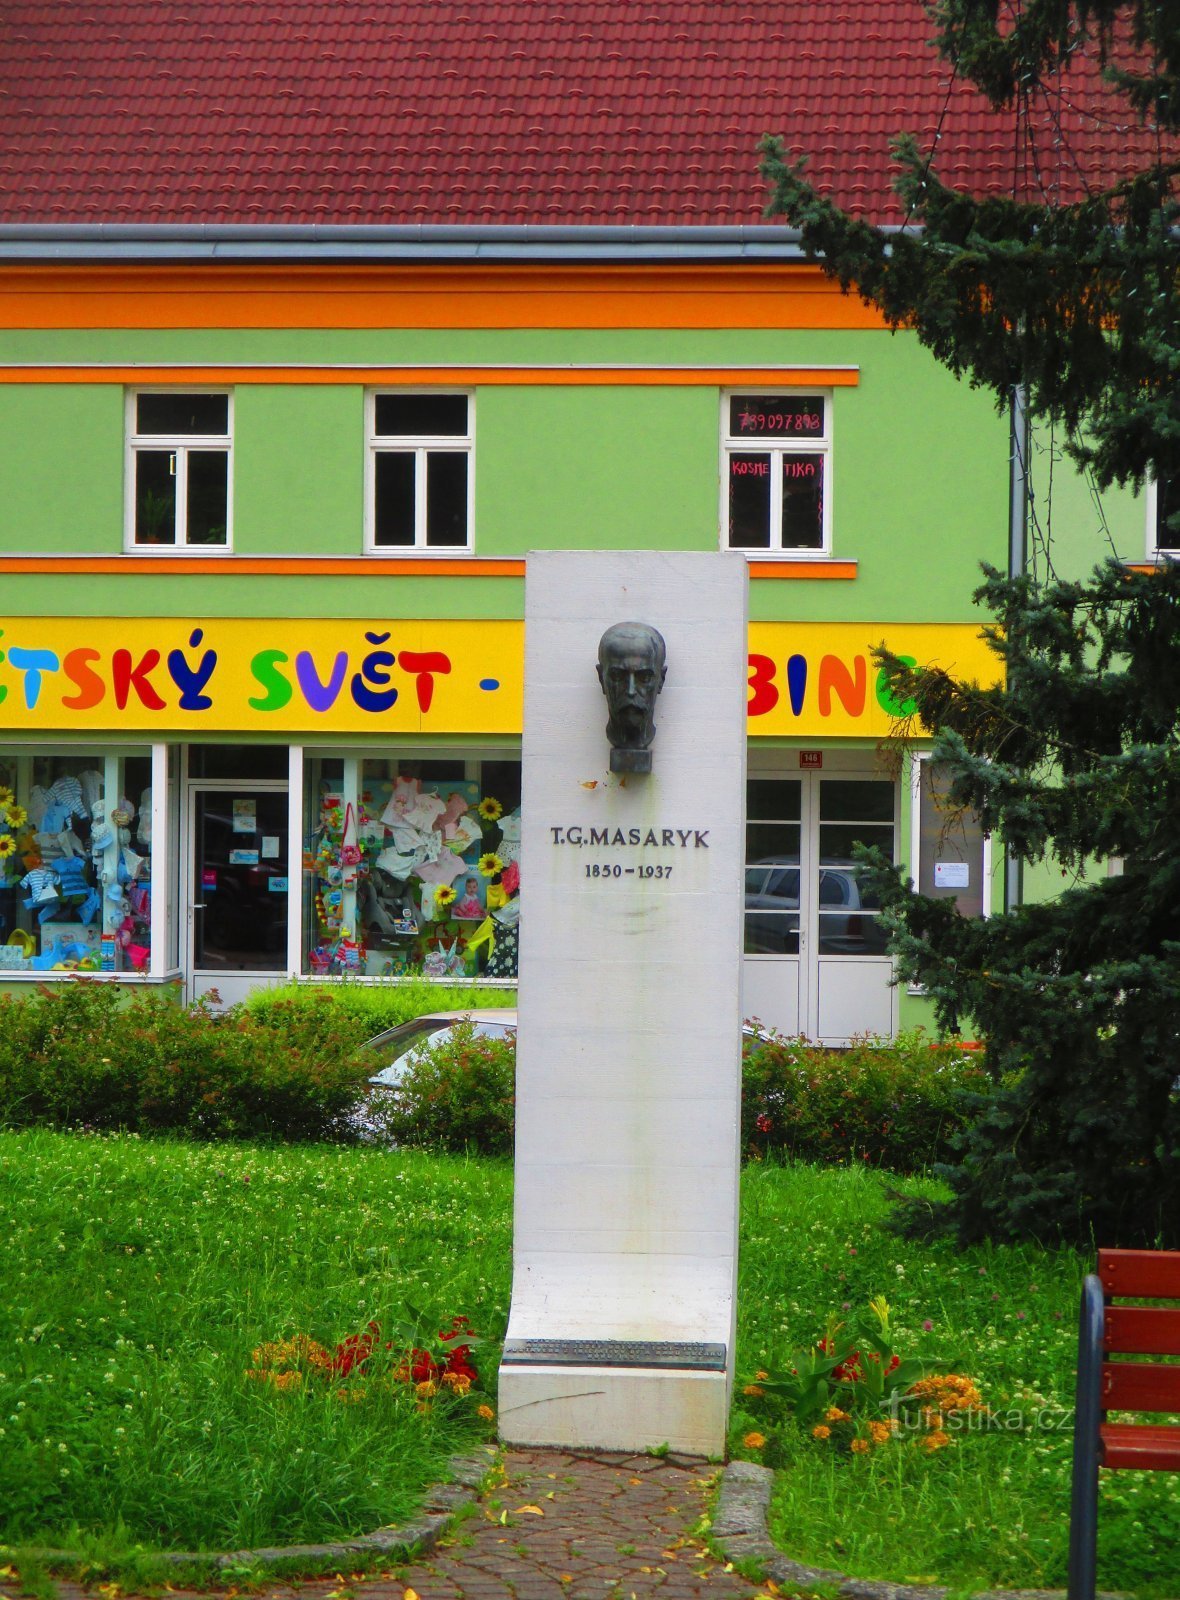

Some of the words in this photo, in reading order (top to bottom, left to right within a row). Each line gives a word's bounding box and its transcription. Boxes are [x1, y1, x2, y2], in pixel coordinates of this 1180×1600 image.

[0, 628, 217, 710] TSKÝ
[248, 632, 452, 713] SVĚT
[804, 753, 818, 762] 146
